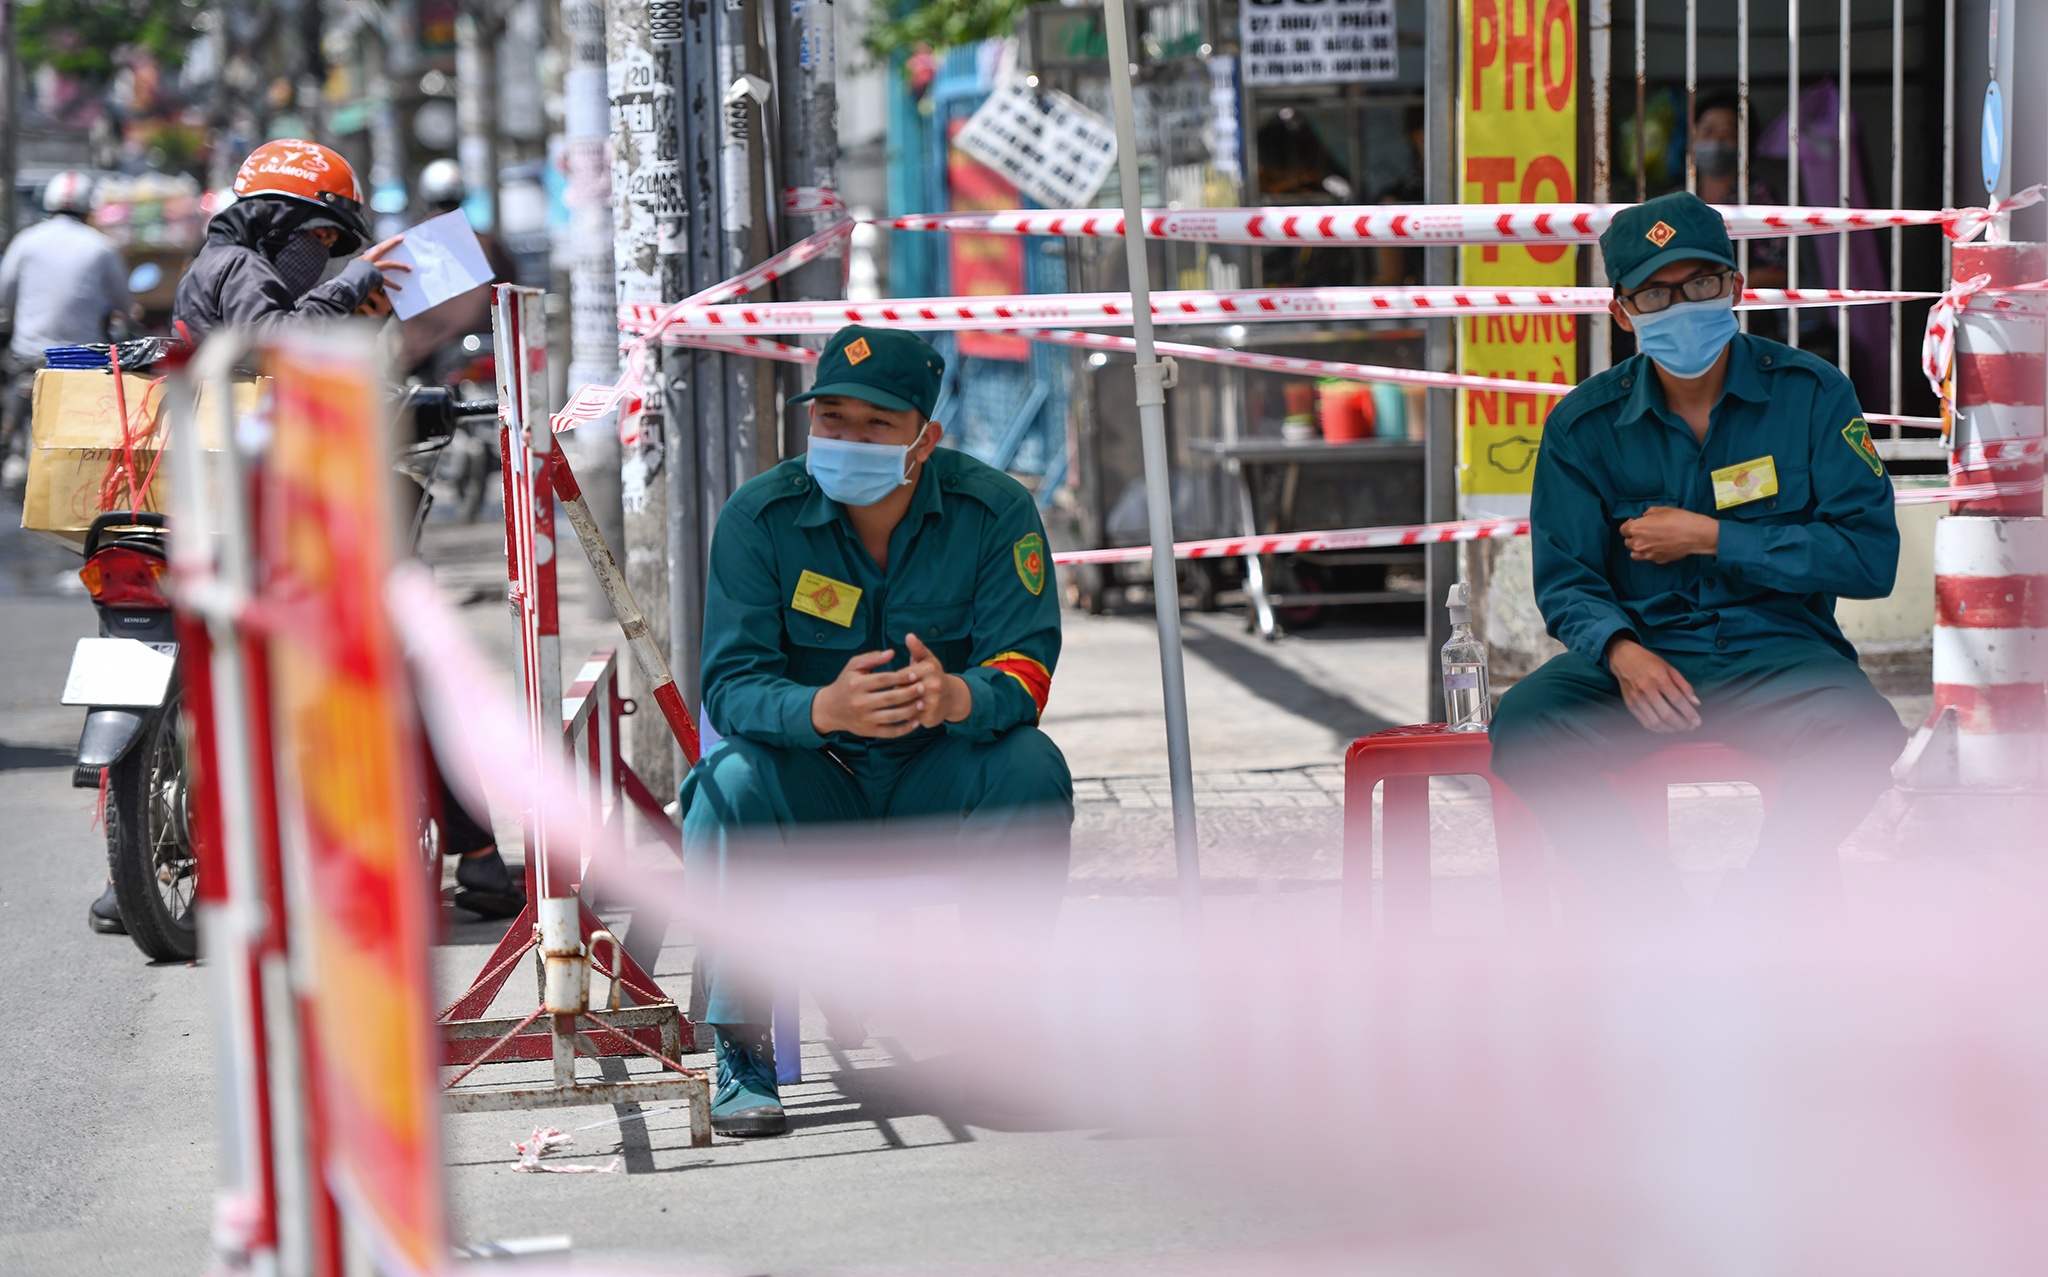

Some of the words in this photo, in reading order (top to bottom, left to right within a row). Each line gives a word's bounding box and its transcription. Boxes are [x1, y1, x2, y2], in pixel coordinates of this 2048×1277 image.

[1472, 0, 1573, 112] PHO
[259, 163, 319, 182] LALAMOVE
[1466, 155, 1575, 263] TO
